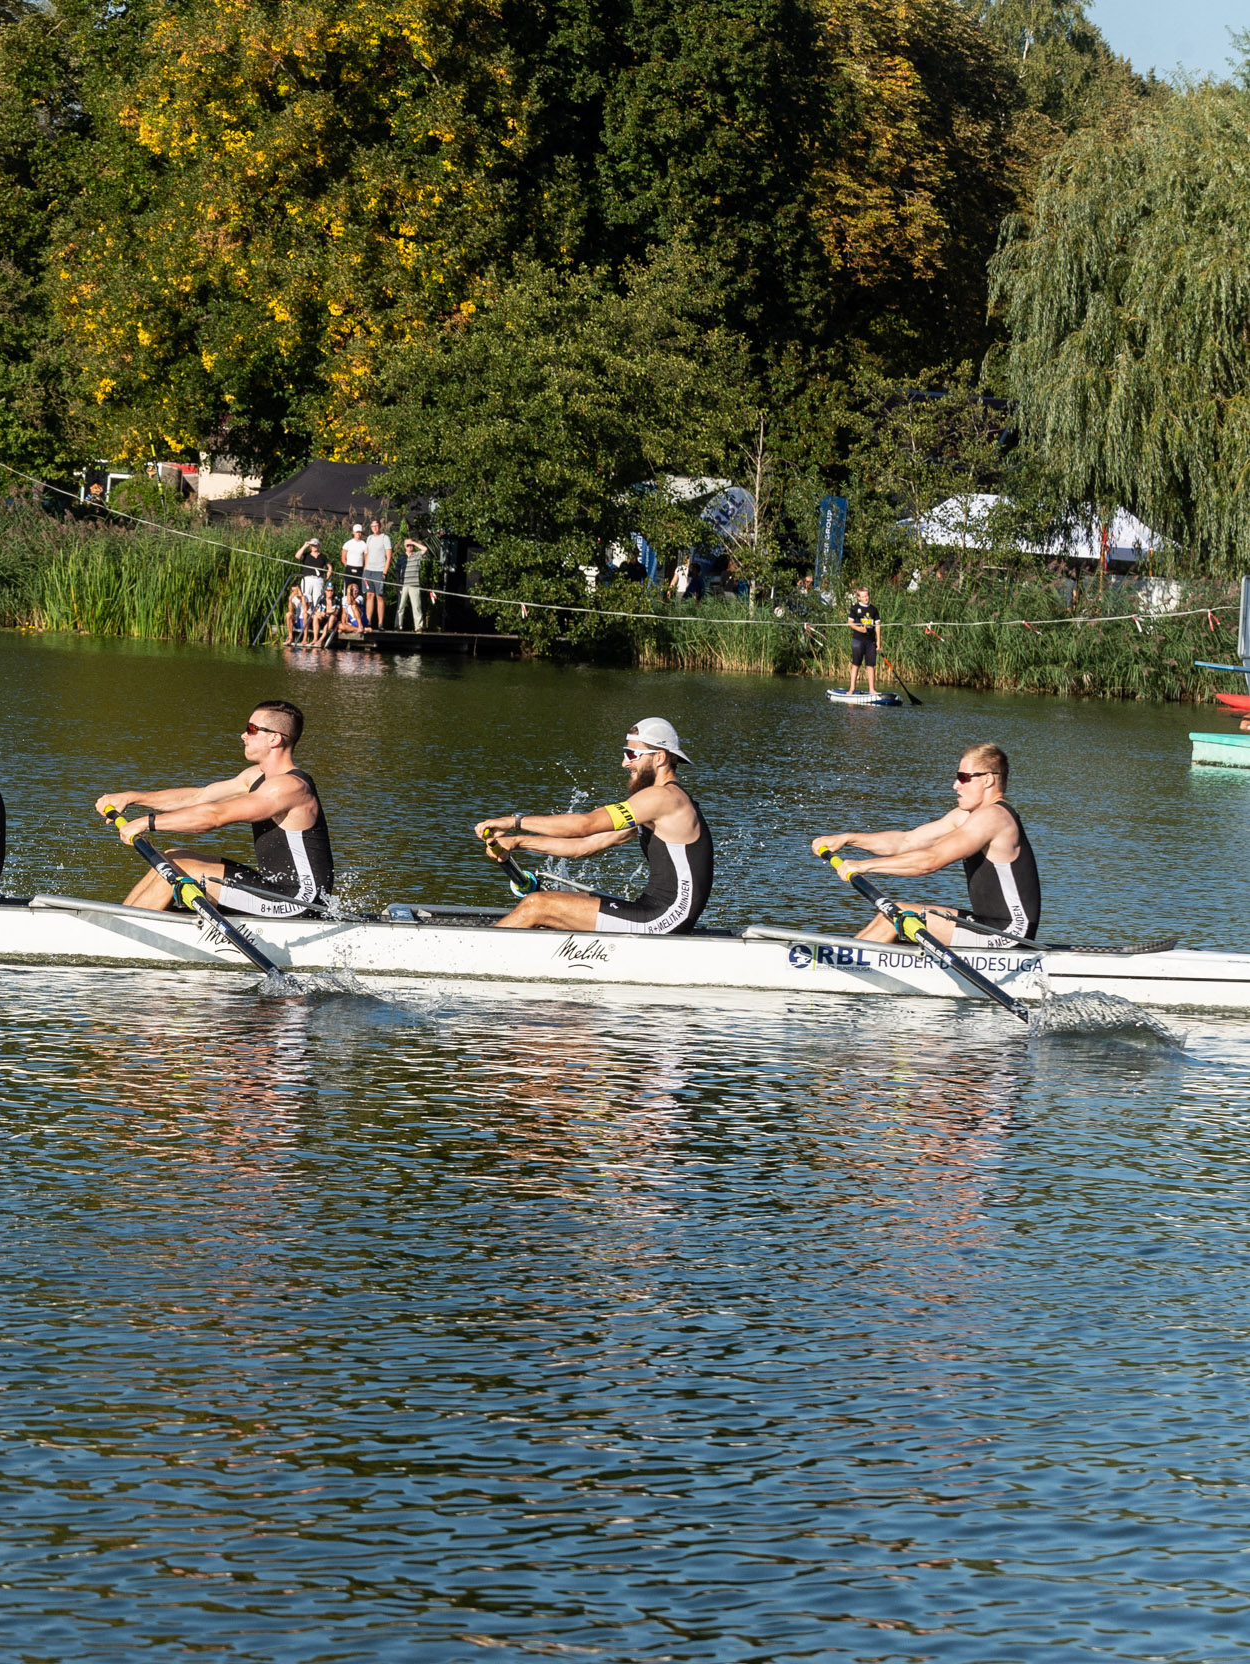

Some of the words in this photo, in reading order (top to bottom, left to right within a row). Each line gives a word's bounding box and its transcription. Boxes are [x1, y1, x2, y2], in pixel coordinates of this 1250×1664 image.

[825, 509, 833, 539] GROUP
[551, 934, 611, 962] Melitta
[817, 945, 871, 965] RBL
